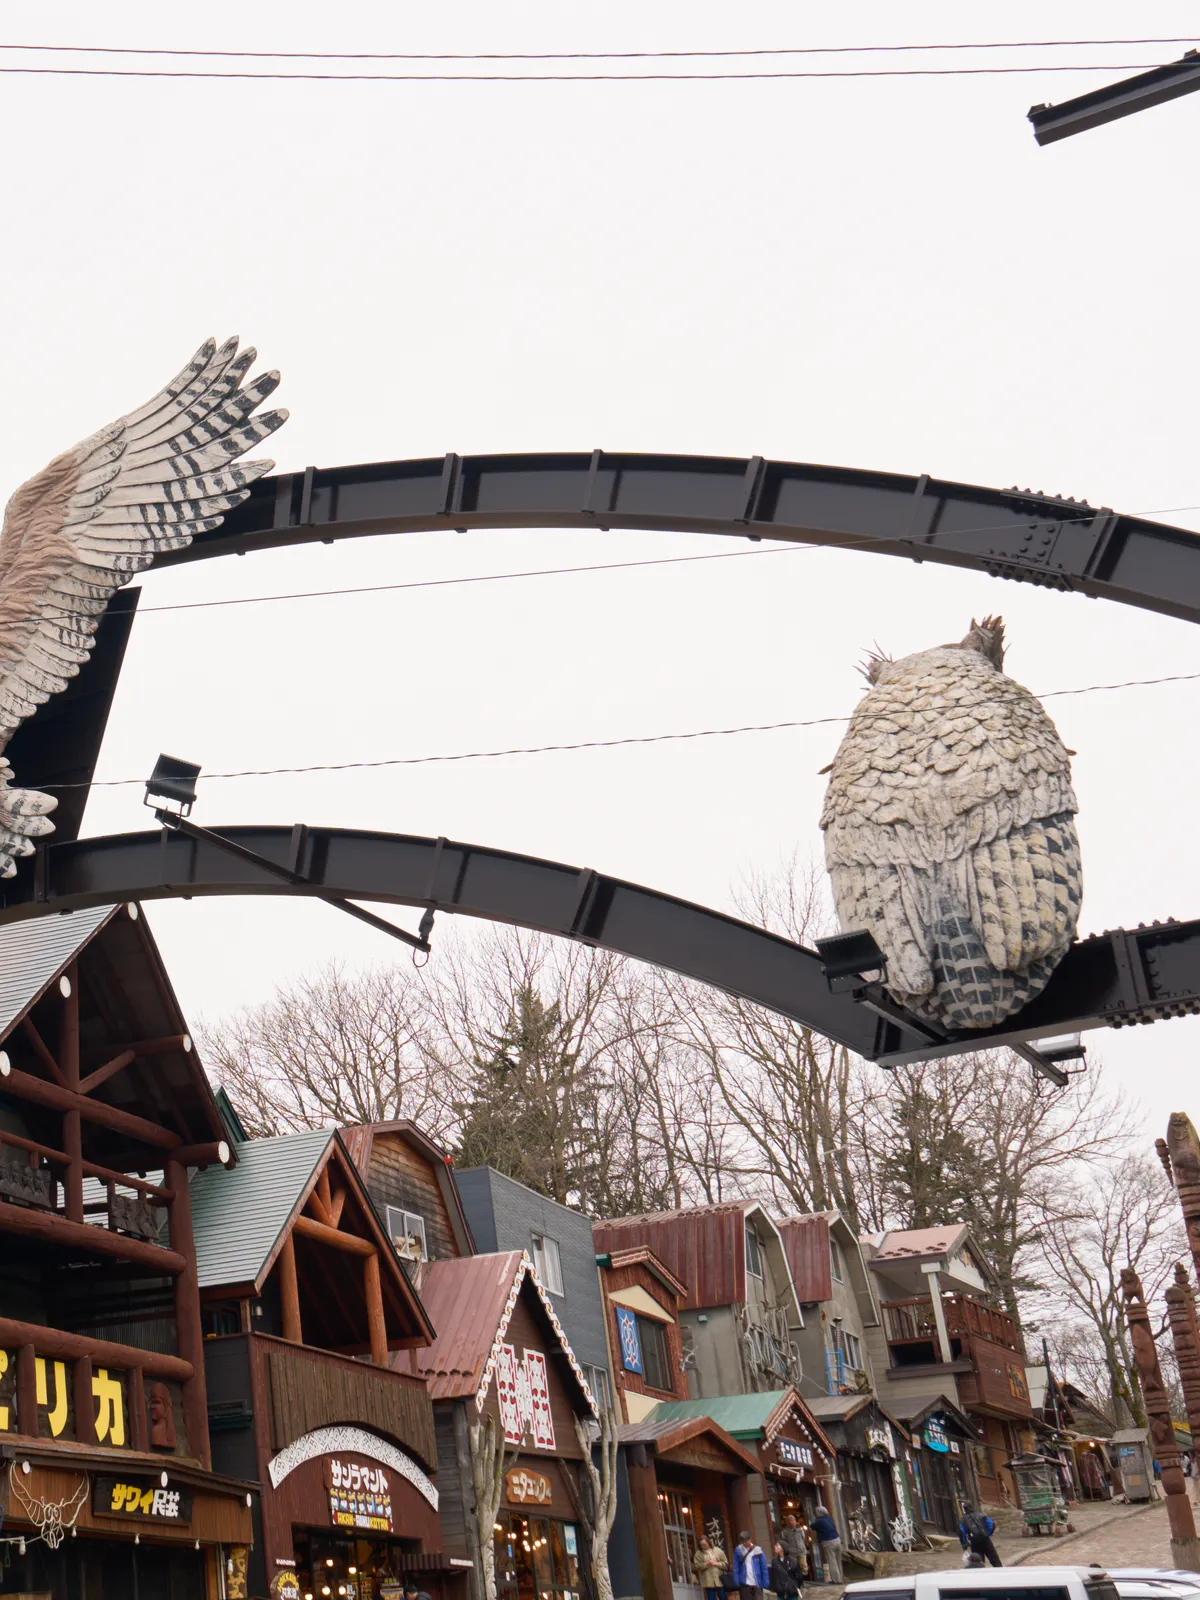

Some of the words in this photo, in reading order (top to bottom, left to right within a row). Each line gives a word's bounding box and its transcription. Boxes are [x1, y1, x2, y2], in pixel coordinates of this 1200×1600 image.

[331, 1459, 389, 1494] サンラマント
[111, 1483, 180, 1517] サワイ民芸
